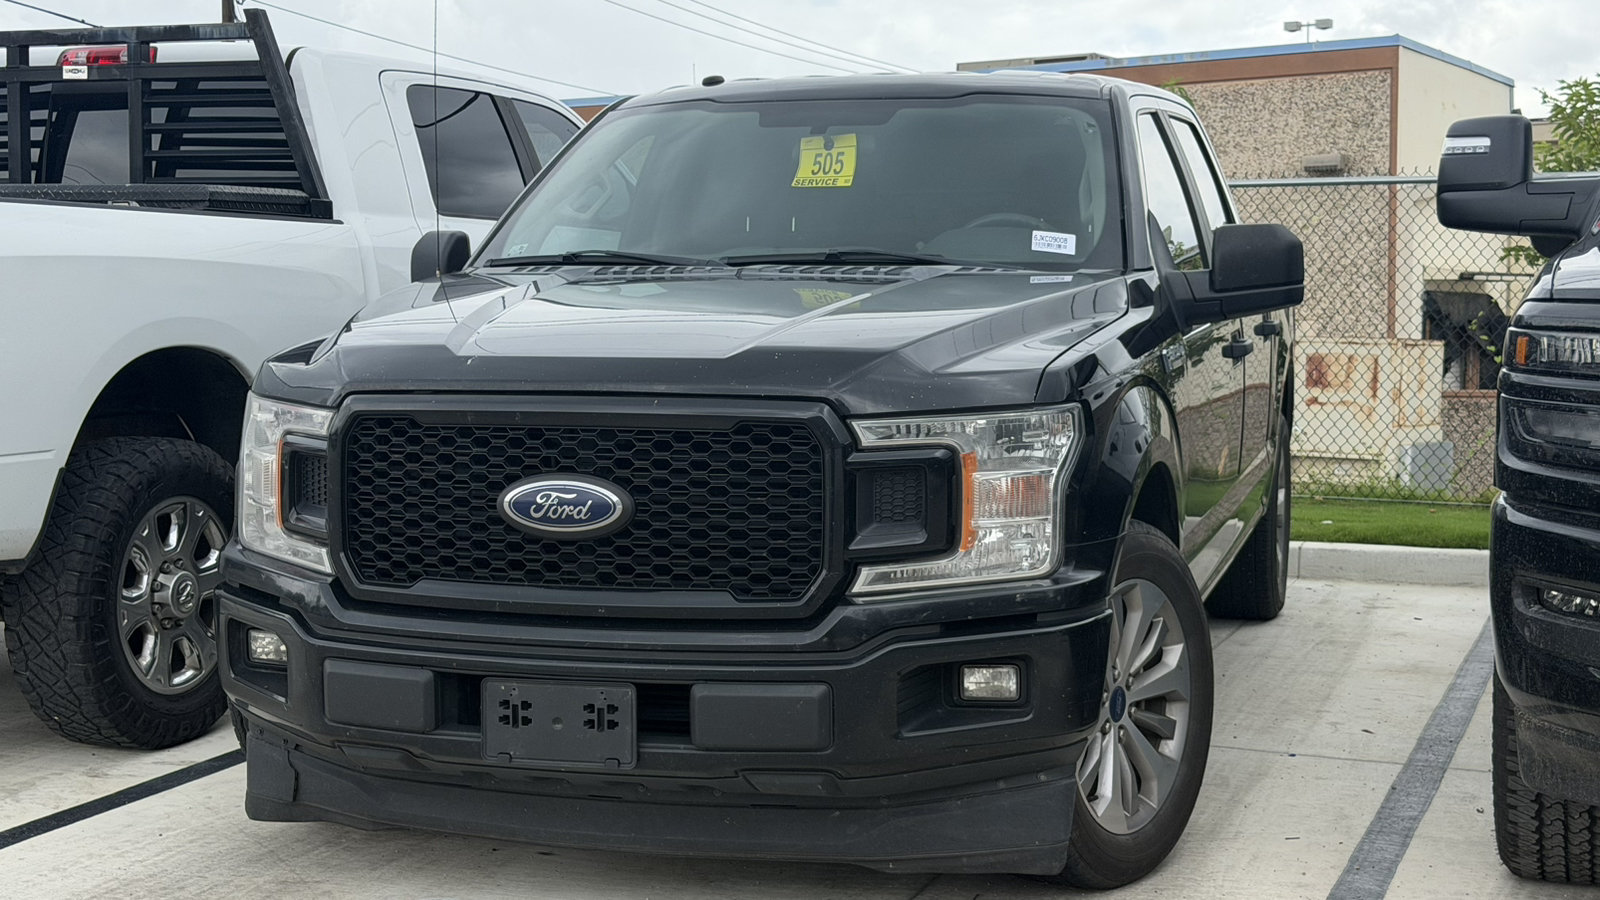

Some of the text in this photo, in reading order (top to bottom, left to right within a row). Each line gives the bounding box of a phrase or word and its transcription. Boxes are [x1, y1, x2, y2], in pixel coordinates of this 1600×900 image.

[811, 151, 845, 176] 505
[793, 178, 839, 186] SERVICE
[530, 491, 593, 520] Ford
